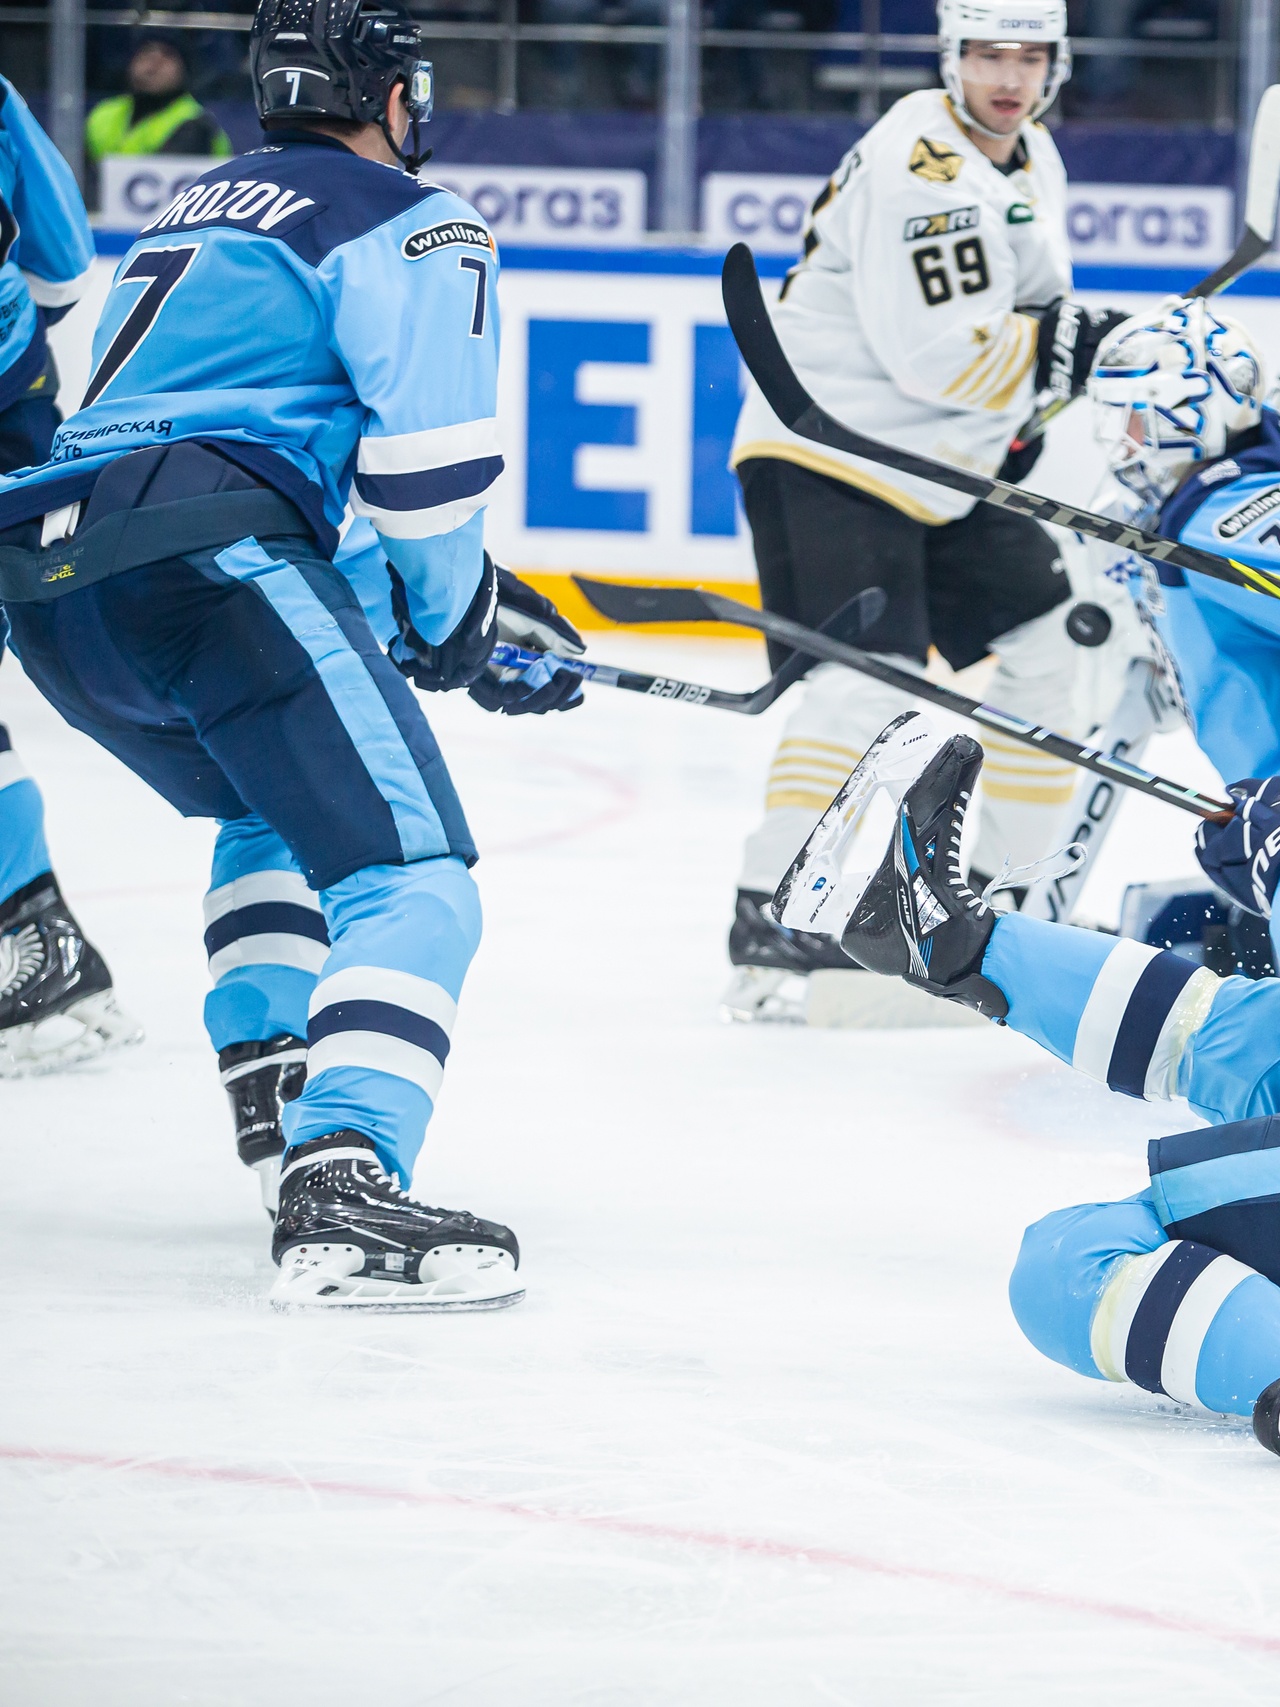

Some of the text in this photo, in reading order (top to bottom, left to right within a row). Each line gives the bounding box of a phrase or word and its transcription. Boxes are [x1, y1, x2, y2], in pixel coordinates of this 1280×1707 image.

[285, 72, 301, 105] 7
[409, 223, 489, 253] Winline
[912, 236, 991, 307] 69
[79, 243, 204, 411] 7
[458, 254, 488, 339] 7
[55, 420, 173, 449] ОСИБИРСКАЯ
[985, 480, 1180, 562] CCM
